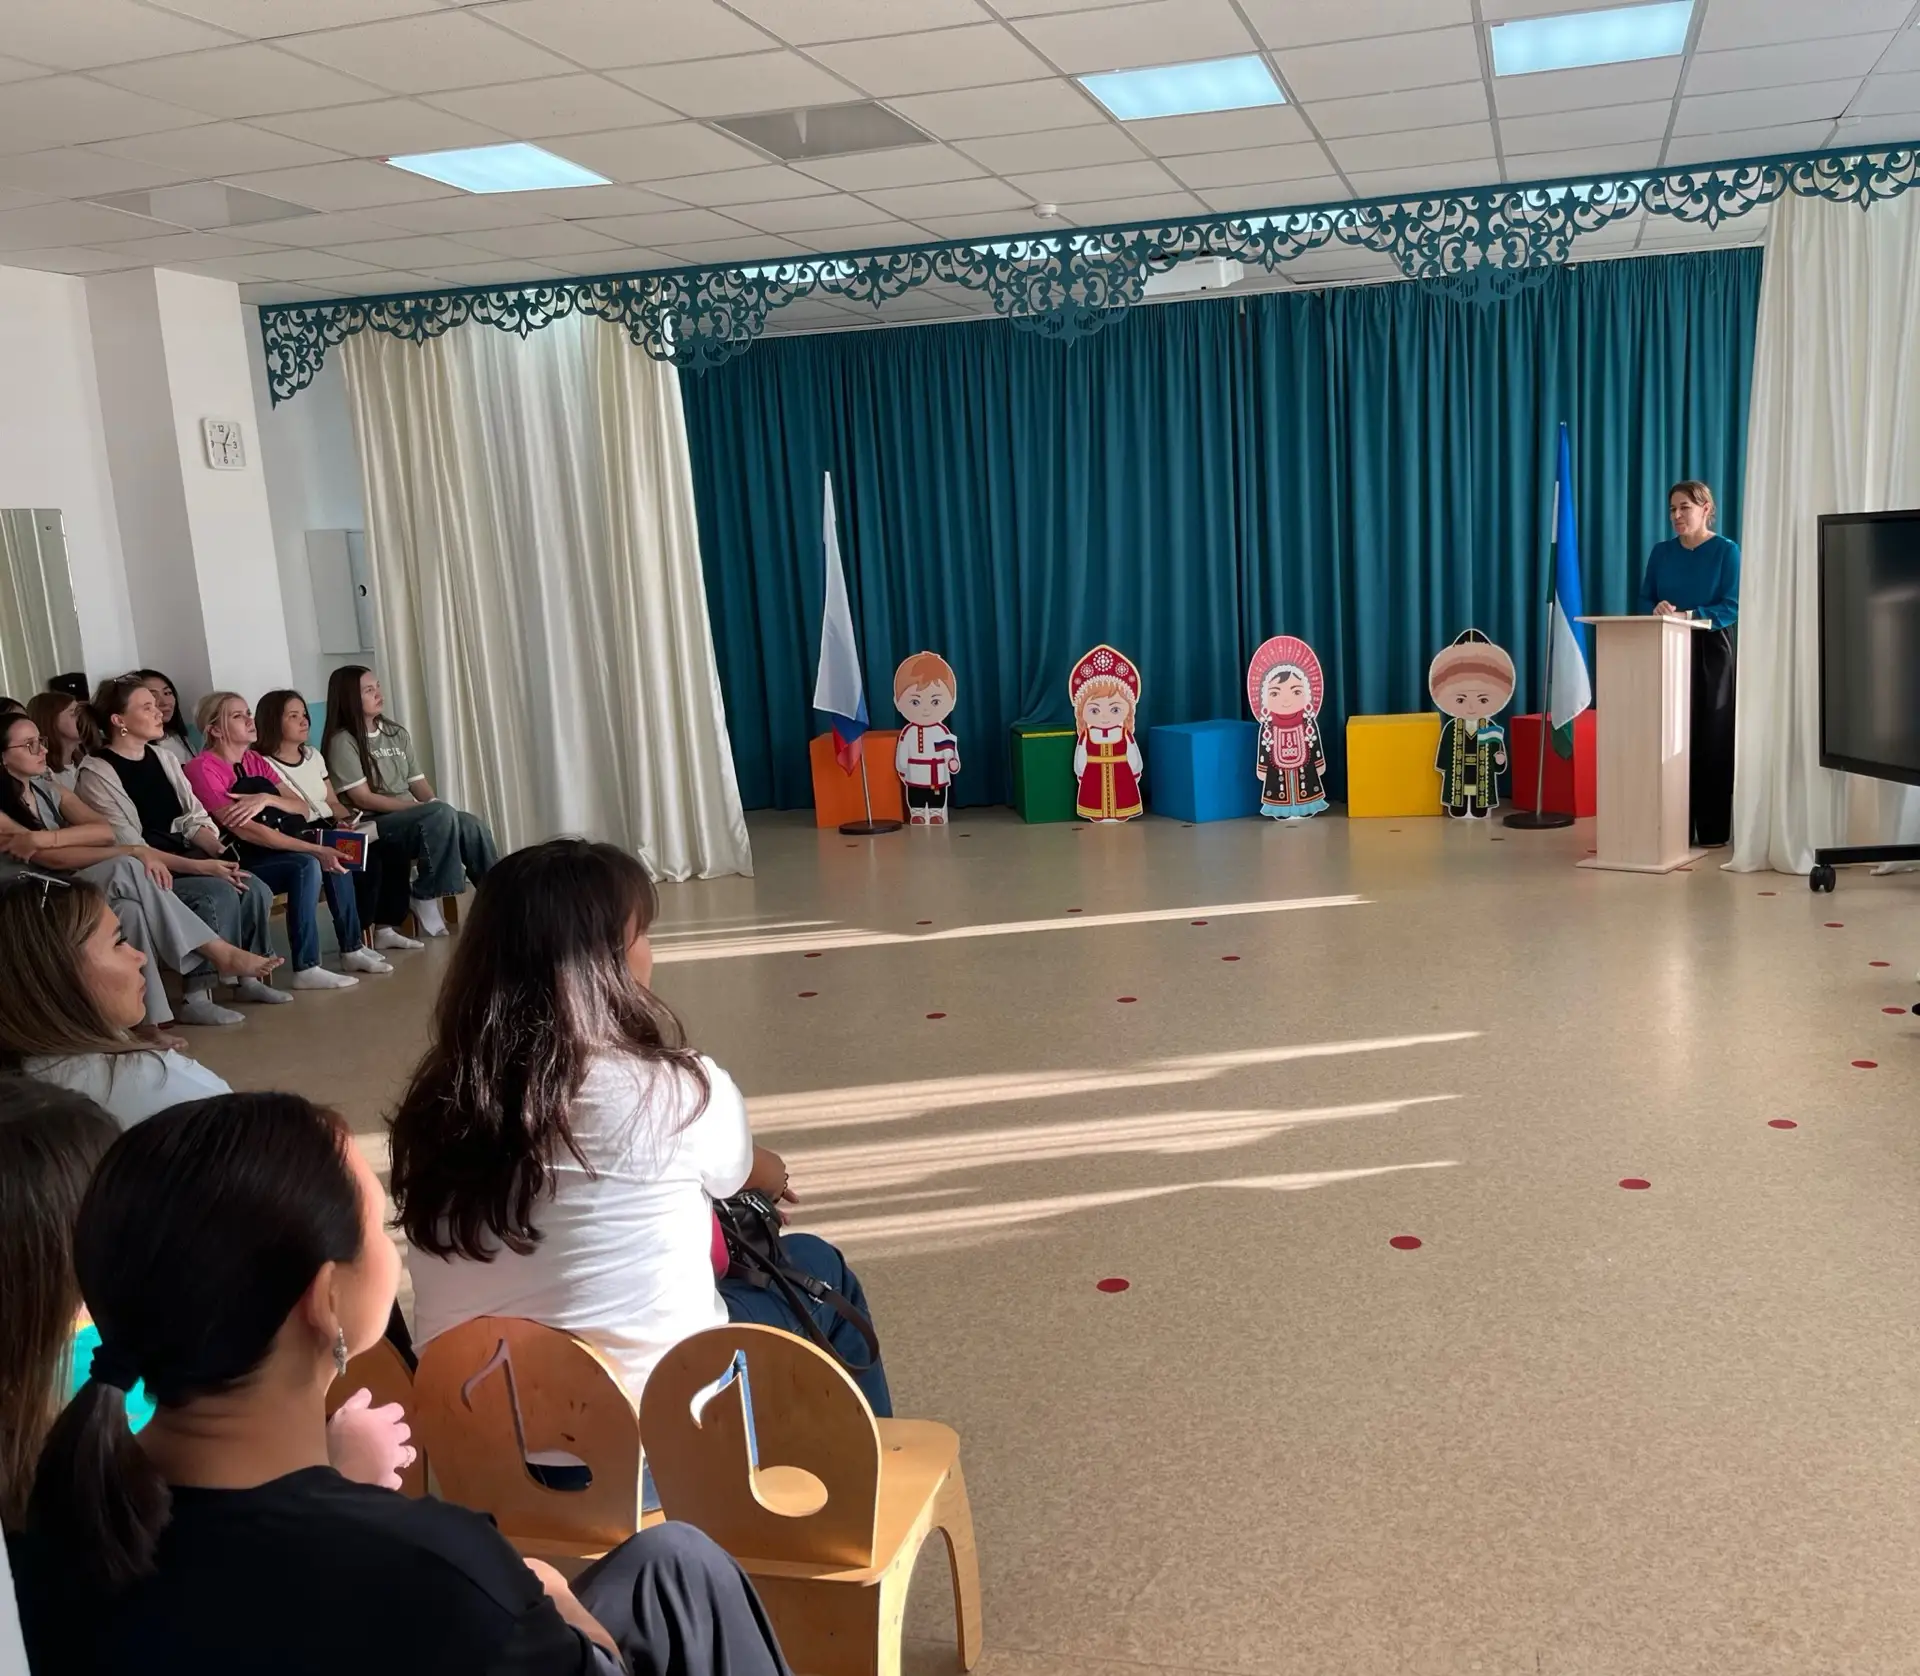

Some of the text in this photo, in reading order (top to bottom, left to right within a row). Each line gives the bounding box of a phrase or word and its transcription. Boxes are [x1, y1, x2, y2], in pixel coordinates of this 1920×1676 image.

[217, 425, 224, 433] 12
[232, 441, 237, 449] 3
[223, 456, 228, 464] 6
